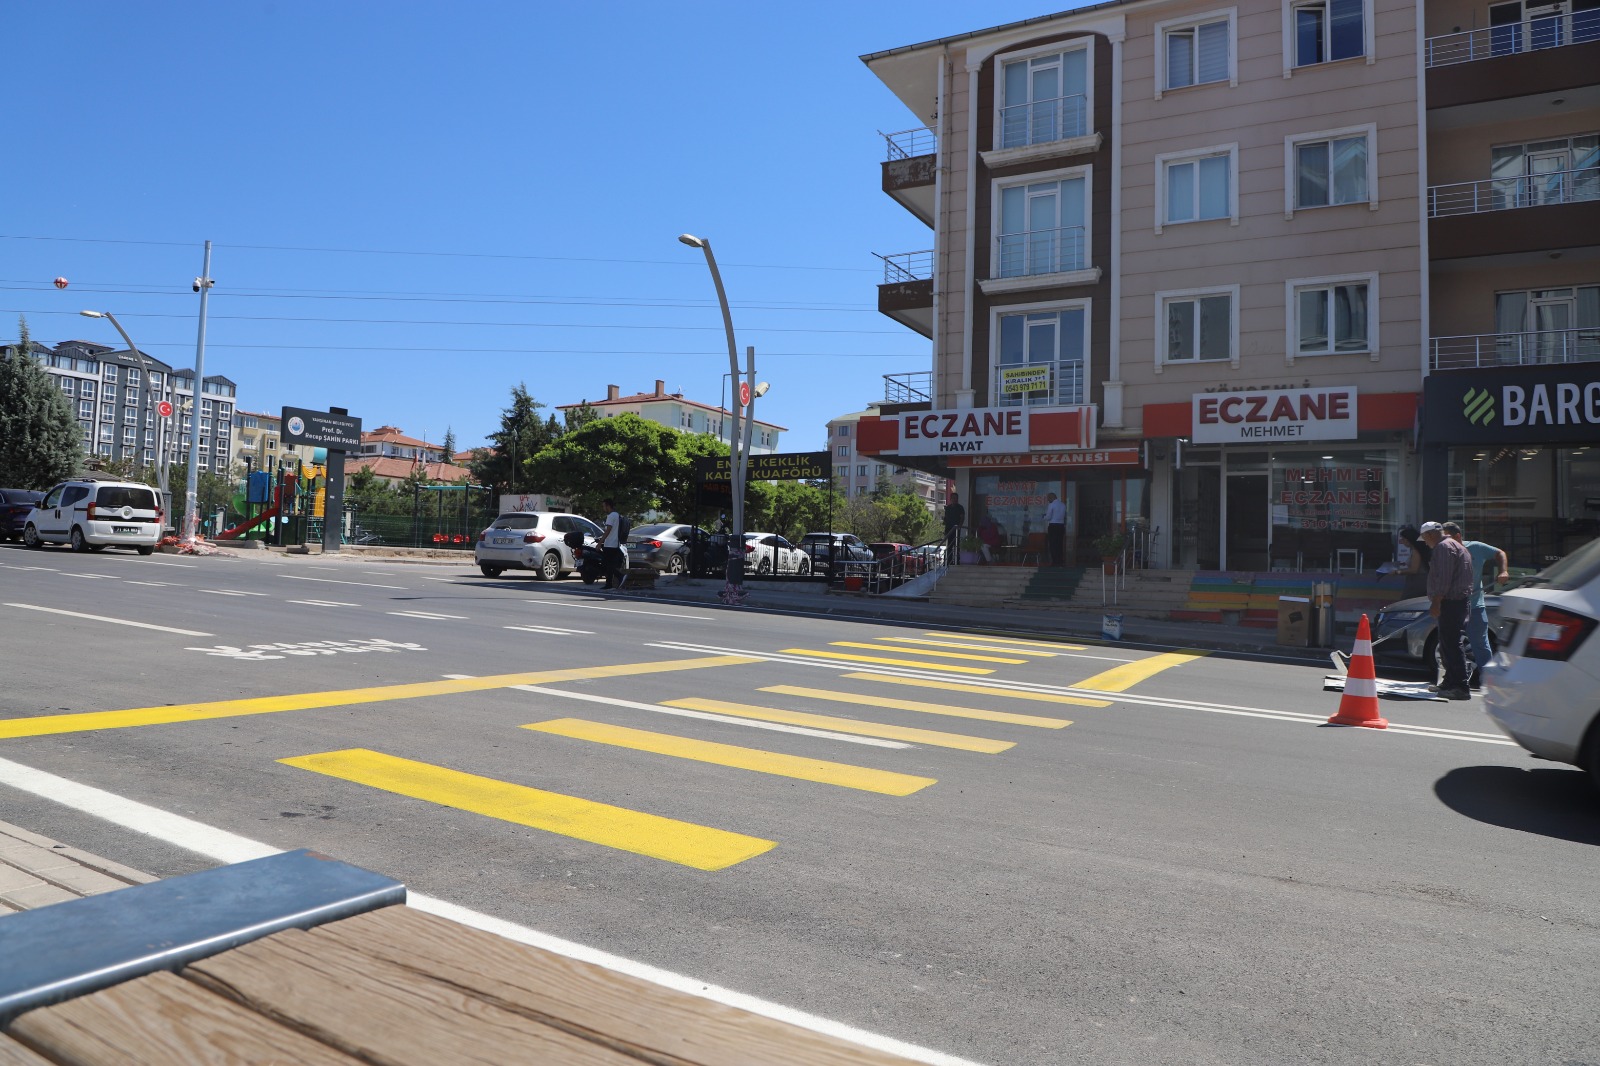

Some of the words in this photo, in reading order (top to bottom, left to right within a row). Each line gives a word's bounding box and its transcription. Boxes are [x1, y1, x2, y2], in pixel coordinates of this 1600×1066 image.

[1005, 384, 1018, 392] 0543
[1039, 381, 1046, 389] 71
[1200, 392, 1350, 424] ECZANE
[904, 411, 1022, 438] ECZANE
[305, 432, 322, 441] Recep
[324, 434, 341, 443] ŞAHİN
[1241, 425, 1304, 438] MEHMET
[940, 440, 984, 452] HAYAT
[716, 459, 755, 469] EME
[760, 455, 810, 467] KEKLİK
[972, 455, 1022, 465] HAYAT
[1032, 452, 1110, 464] ECZANESİ
[752, 465, 822, 479] KUAFÖRÜ
[1285, 468, 1384, 482] MEHMET
[997, 481, 1038, 491] HAYAT
[985, 494, 1048, 506] ECZANESİ
[1280, 488, 1390, 504] ECZANESİ
[1302, 520, 1328, 528] 310
